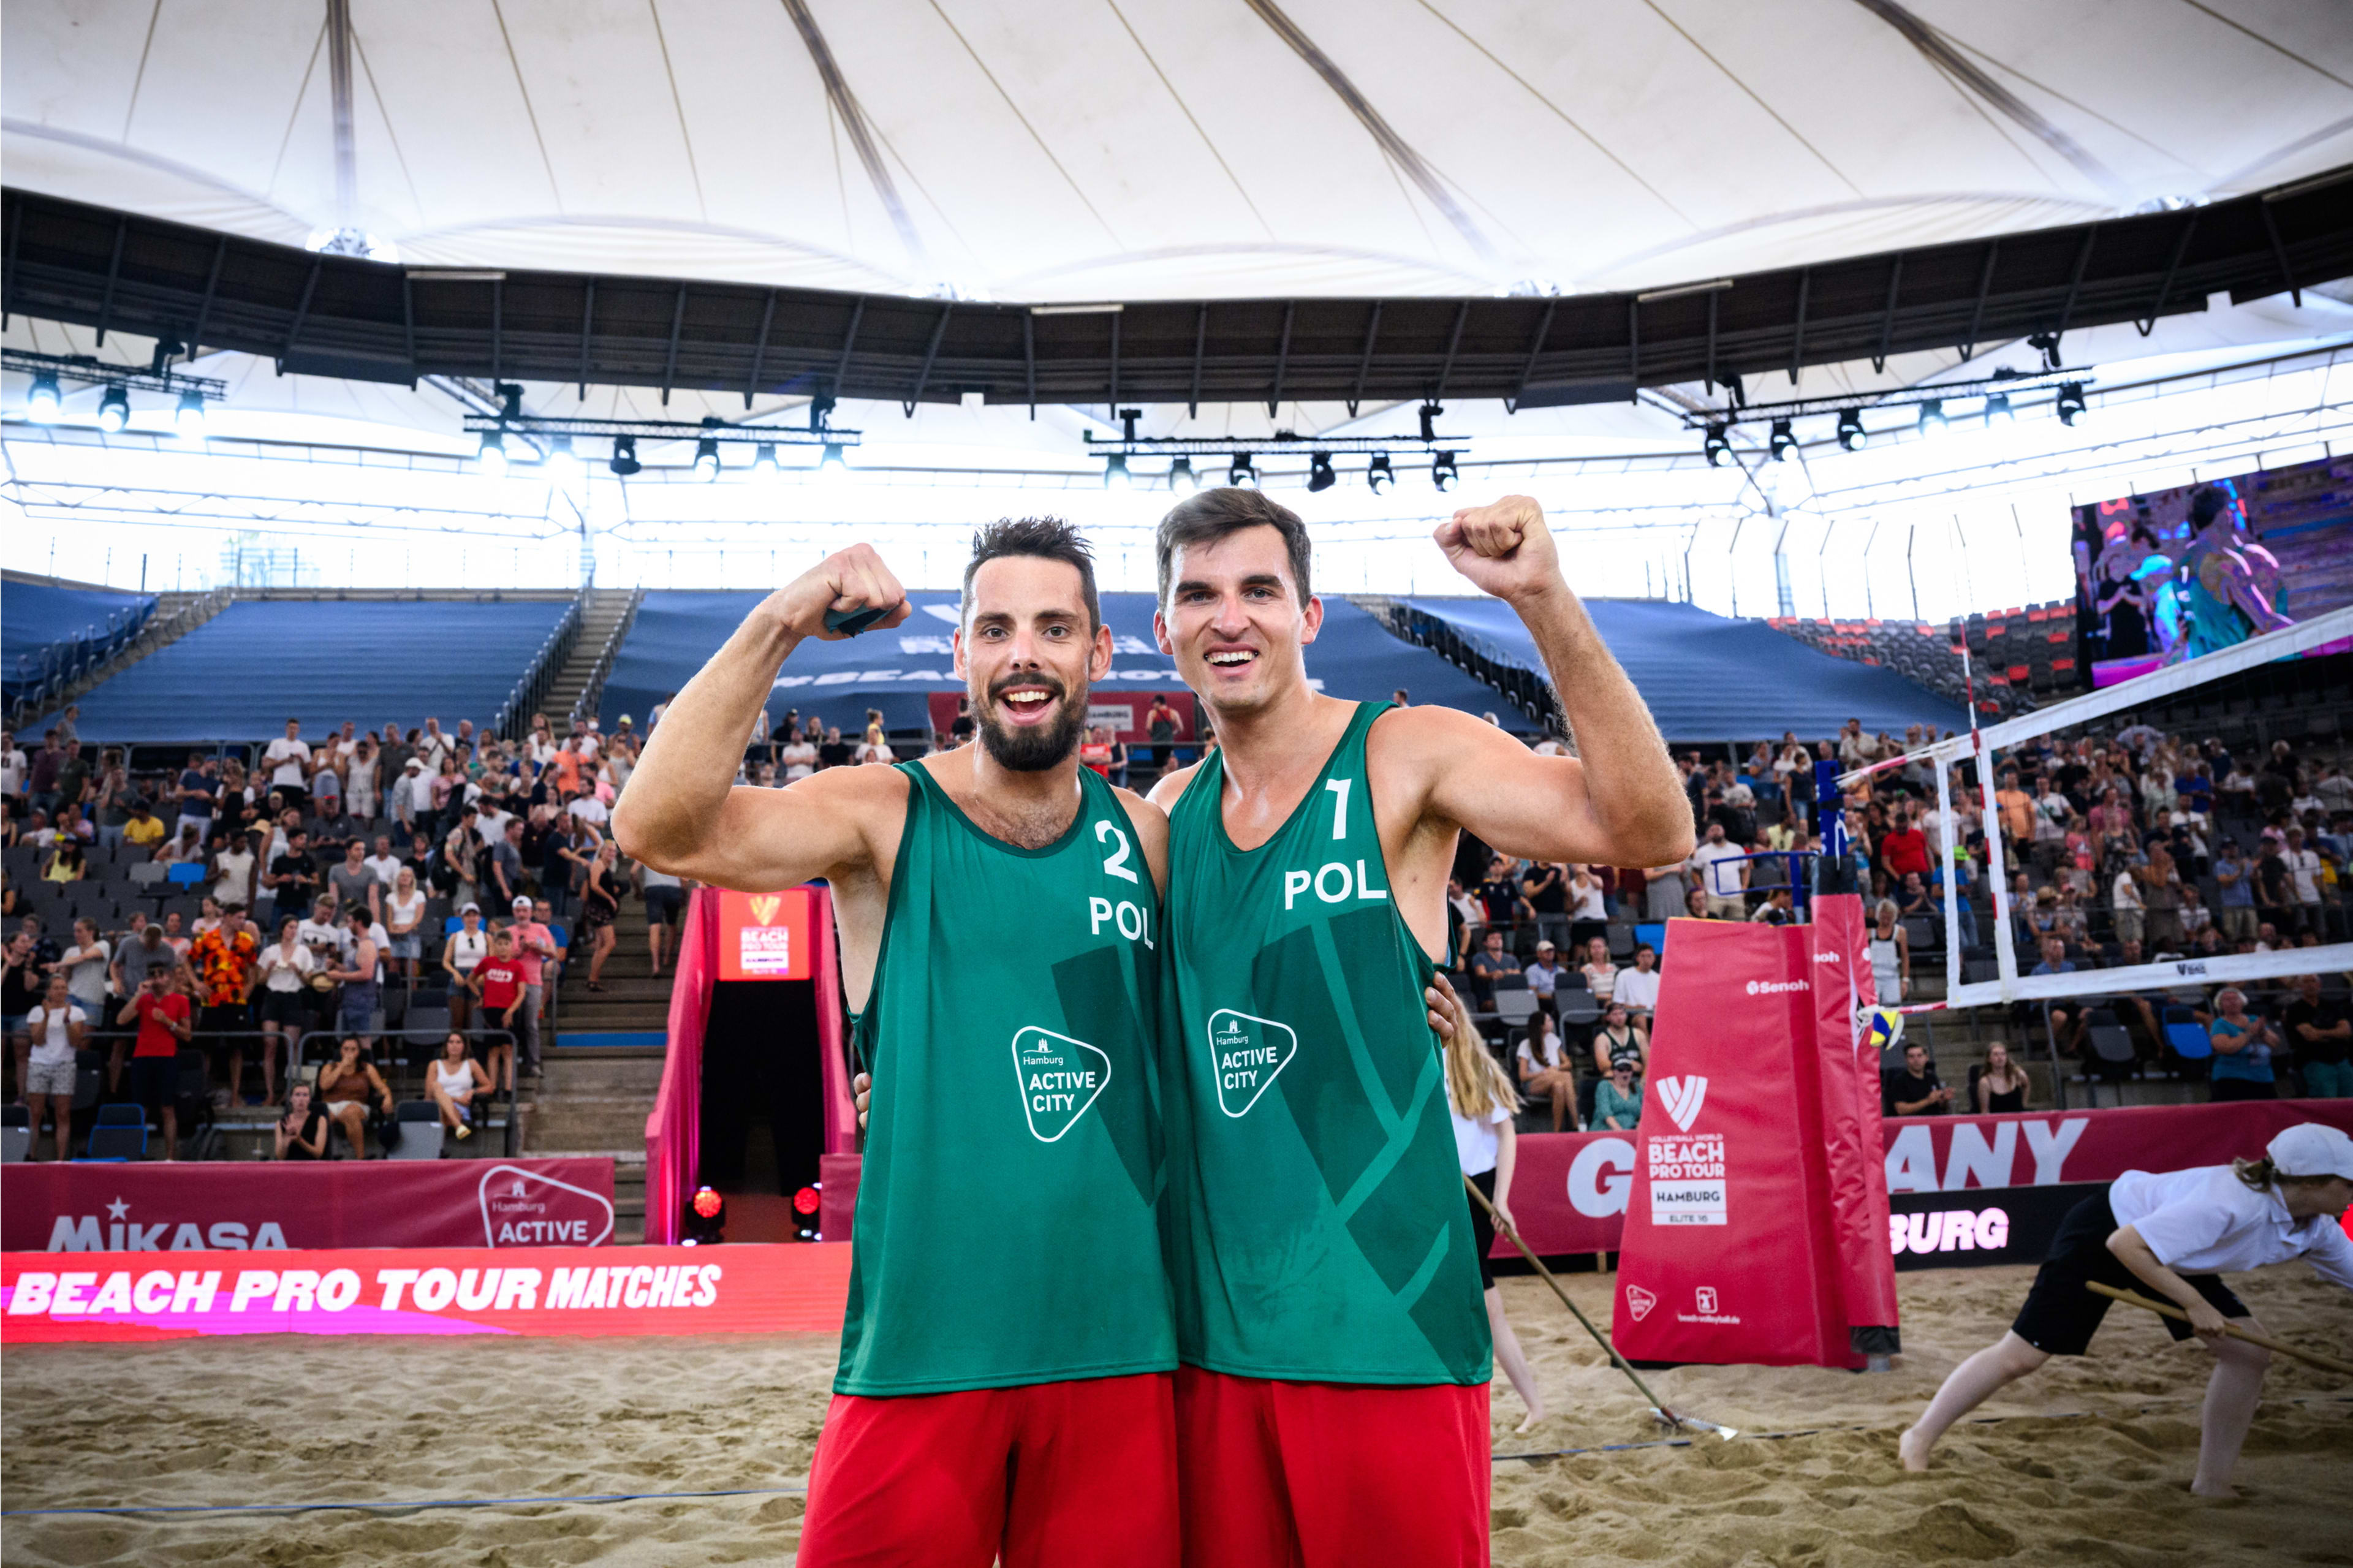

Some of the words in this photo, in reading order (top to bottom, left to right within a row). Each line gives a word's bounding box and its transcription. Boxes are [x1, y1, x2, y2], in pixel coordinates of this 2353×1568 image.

[1325, 778, 1352, 841] 1
[1094, 819, 1139, 885] 2
[1285, 859, 1387, 910] POL
[1089, 896, 1154, 950] POL
[1759, 979, 1809, 994] Senoh
[1216, 1035, 1249, 1046] Hamburg
[1023, 1056, 1064, 1066] Hamburg
[1221, 1046, 1278, 1069] ACTIVE
[1029, 1071, 1096, 1091] ACTIVE
[1224, 1070, 1258, 1090] CITY
[1033, 1094, 1075, 1113] CITY
[1648, 1142, 1725, 1164] BEACH
[1649, 1165, 1683, 1179] PRO
[1683, 1163, 1726, 1178] TOUR
[1656, 1191, 1721, 1203] HAMBURG
[492, 1202, 546, 1214] Hamburg
[1669, 1214, 1695, 1223] ELITE
[498, 1220, 588, 1243] ACTIVE
[7, 1270, 222, 1315] BEACH
[229, 1268, 362, 1312] PRO
[376, 1267, 543, 1311] TOUR
[544, 1263, 722, 1310] MATCHES
